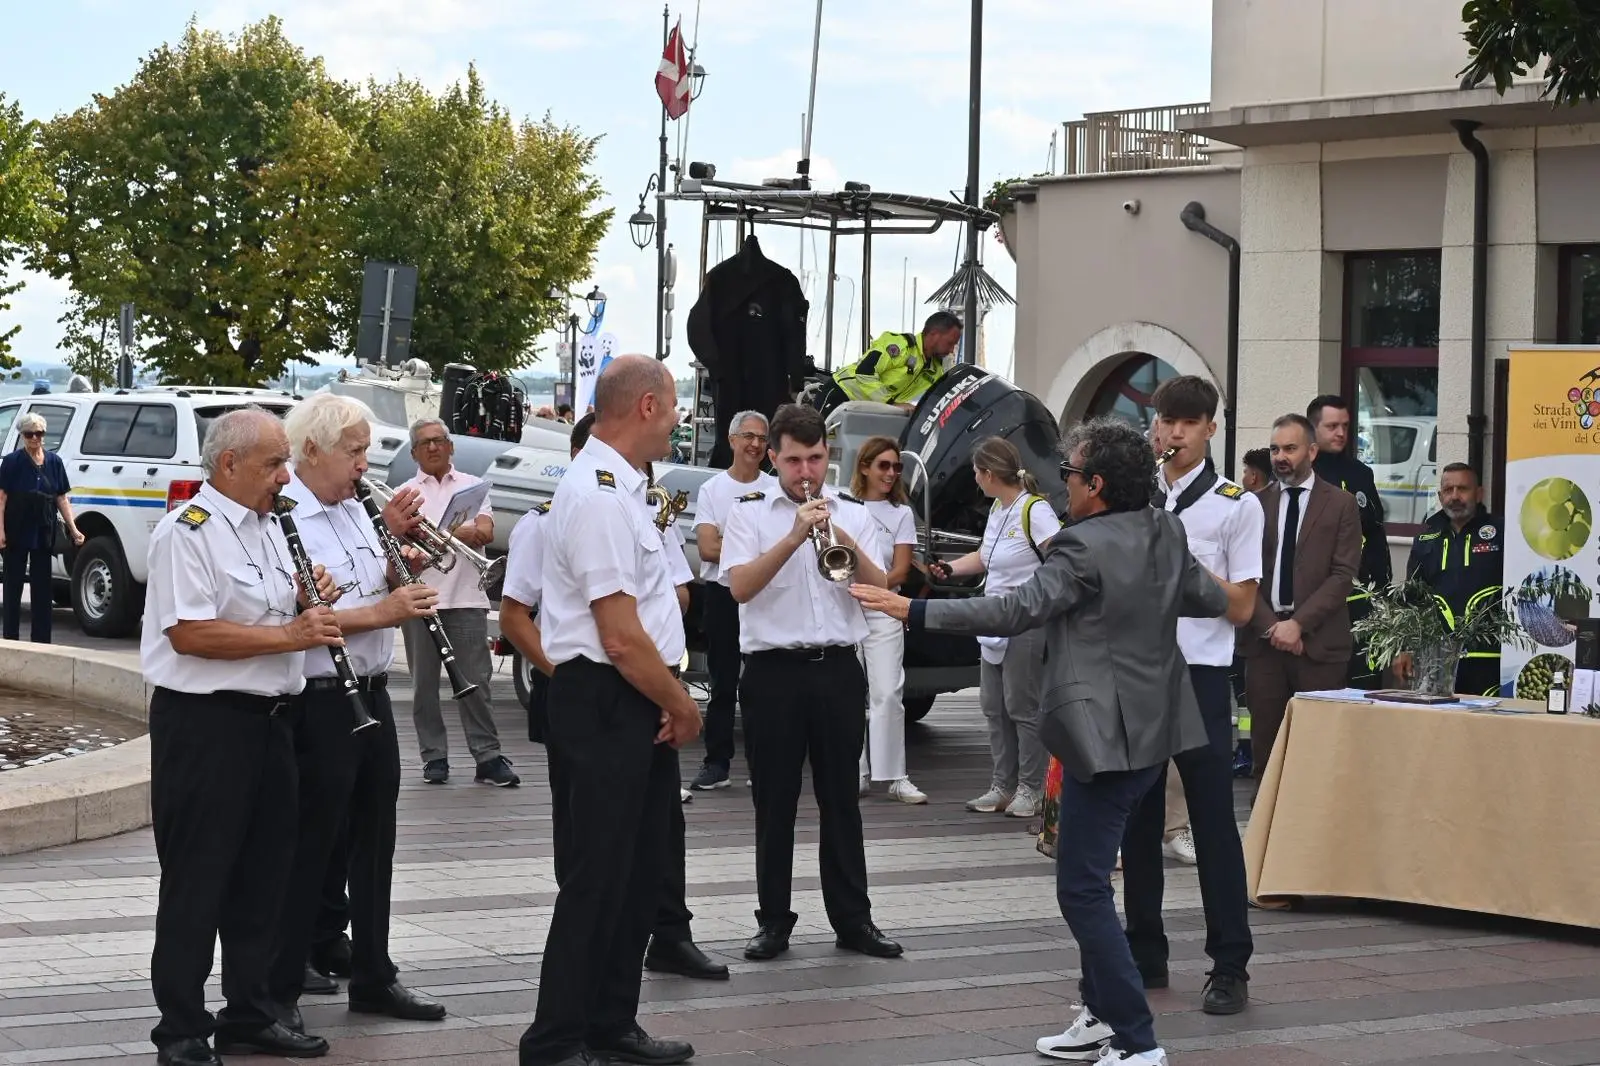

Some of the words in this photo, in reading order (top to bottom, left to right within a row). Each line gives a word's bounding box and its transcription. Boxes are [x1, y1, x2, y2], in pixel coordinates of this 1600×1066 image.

[580, 368, 596, 378] WWF
[920, 374, 978, 435] SUZUKI
[1533, 402, 1571, 416] Strada
[1533, 419, 1547, 429] dei
[1551, 417, 1576, 429] Vini
[1574, 433, 1588, 443] del
